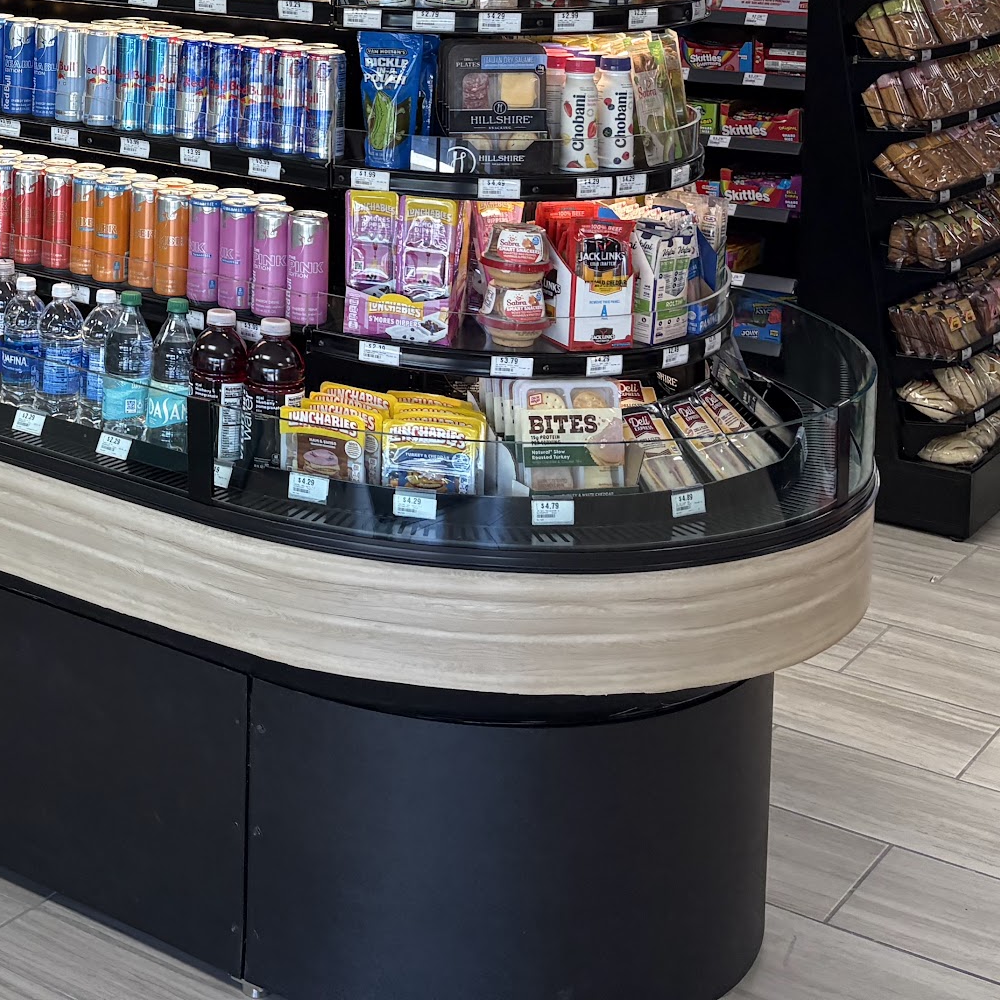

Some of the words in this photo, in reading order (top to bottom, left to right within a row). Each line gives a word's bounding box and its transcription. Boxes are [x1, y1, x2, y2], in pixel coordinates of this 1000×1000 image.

[690, 53, 722, 64] Skittles
[470, 116, 532, 125] HILLSHIRE
[572, 94, 586, 152] Chobani
[614, 91, 628, 148] Chobani
[722, 124, 768, 138] Skittles
[478, 154, 524, 162] HILLSHIRE
[724, 190, 770, 203] Skittles
[500, 238, 520, 247] Sabra
[578, 252, 600, 262] JACK
[368, 315, 394, 326] S'MORES
[619, 382, 639, 392] Deli
[679, 406, 695, 417] Deli
[528, 414, 598, 434] BITES
[628, 416, 650, 428] Deli
[298, 478, 315, 486] $4.29
[402, 496, 422, 505] $4.29
[540, 502, 560, 510] $4.79
